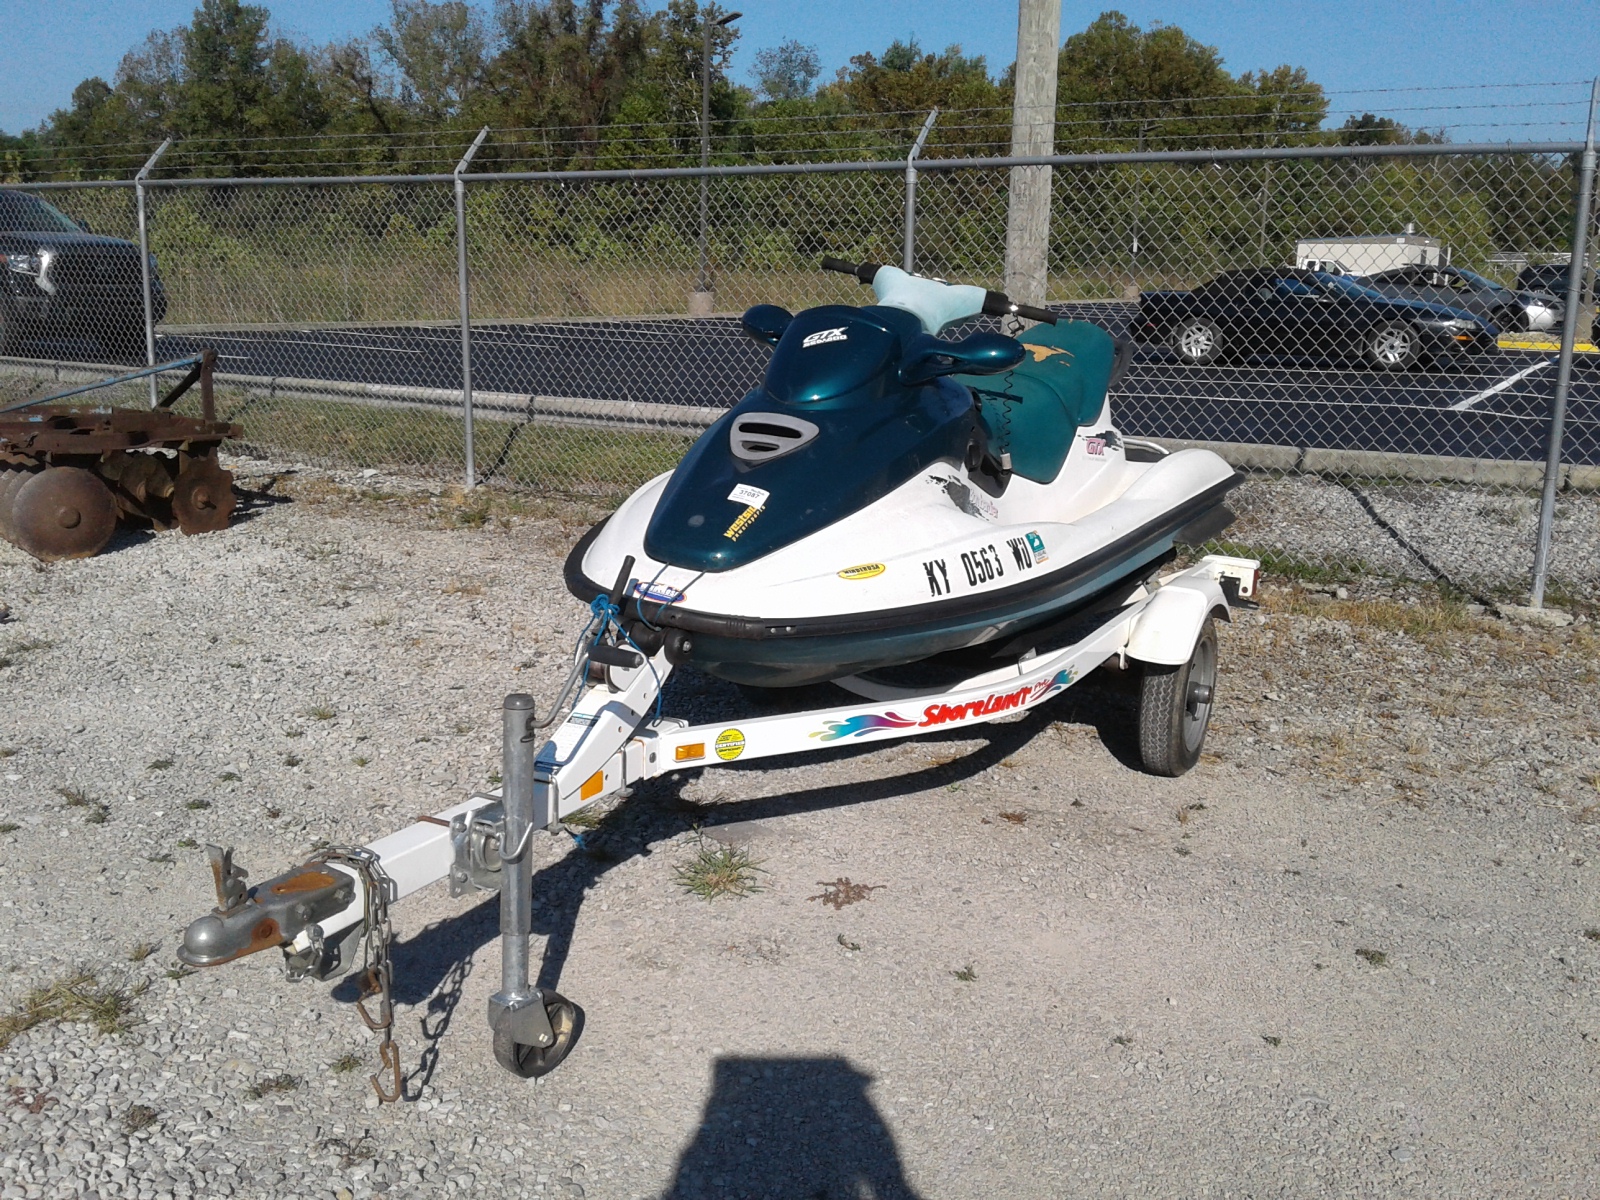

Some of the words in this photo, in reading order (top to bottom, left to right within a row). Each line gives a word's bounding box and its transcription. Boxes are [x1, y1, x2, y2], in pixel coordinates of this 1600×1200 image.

[803, 326, 849, 343] GTX
[723, 505, 758, 538] westsi
[922, 559, 951, 597] KY
[960, 544, 1004, 587] 0563
